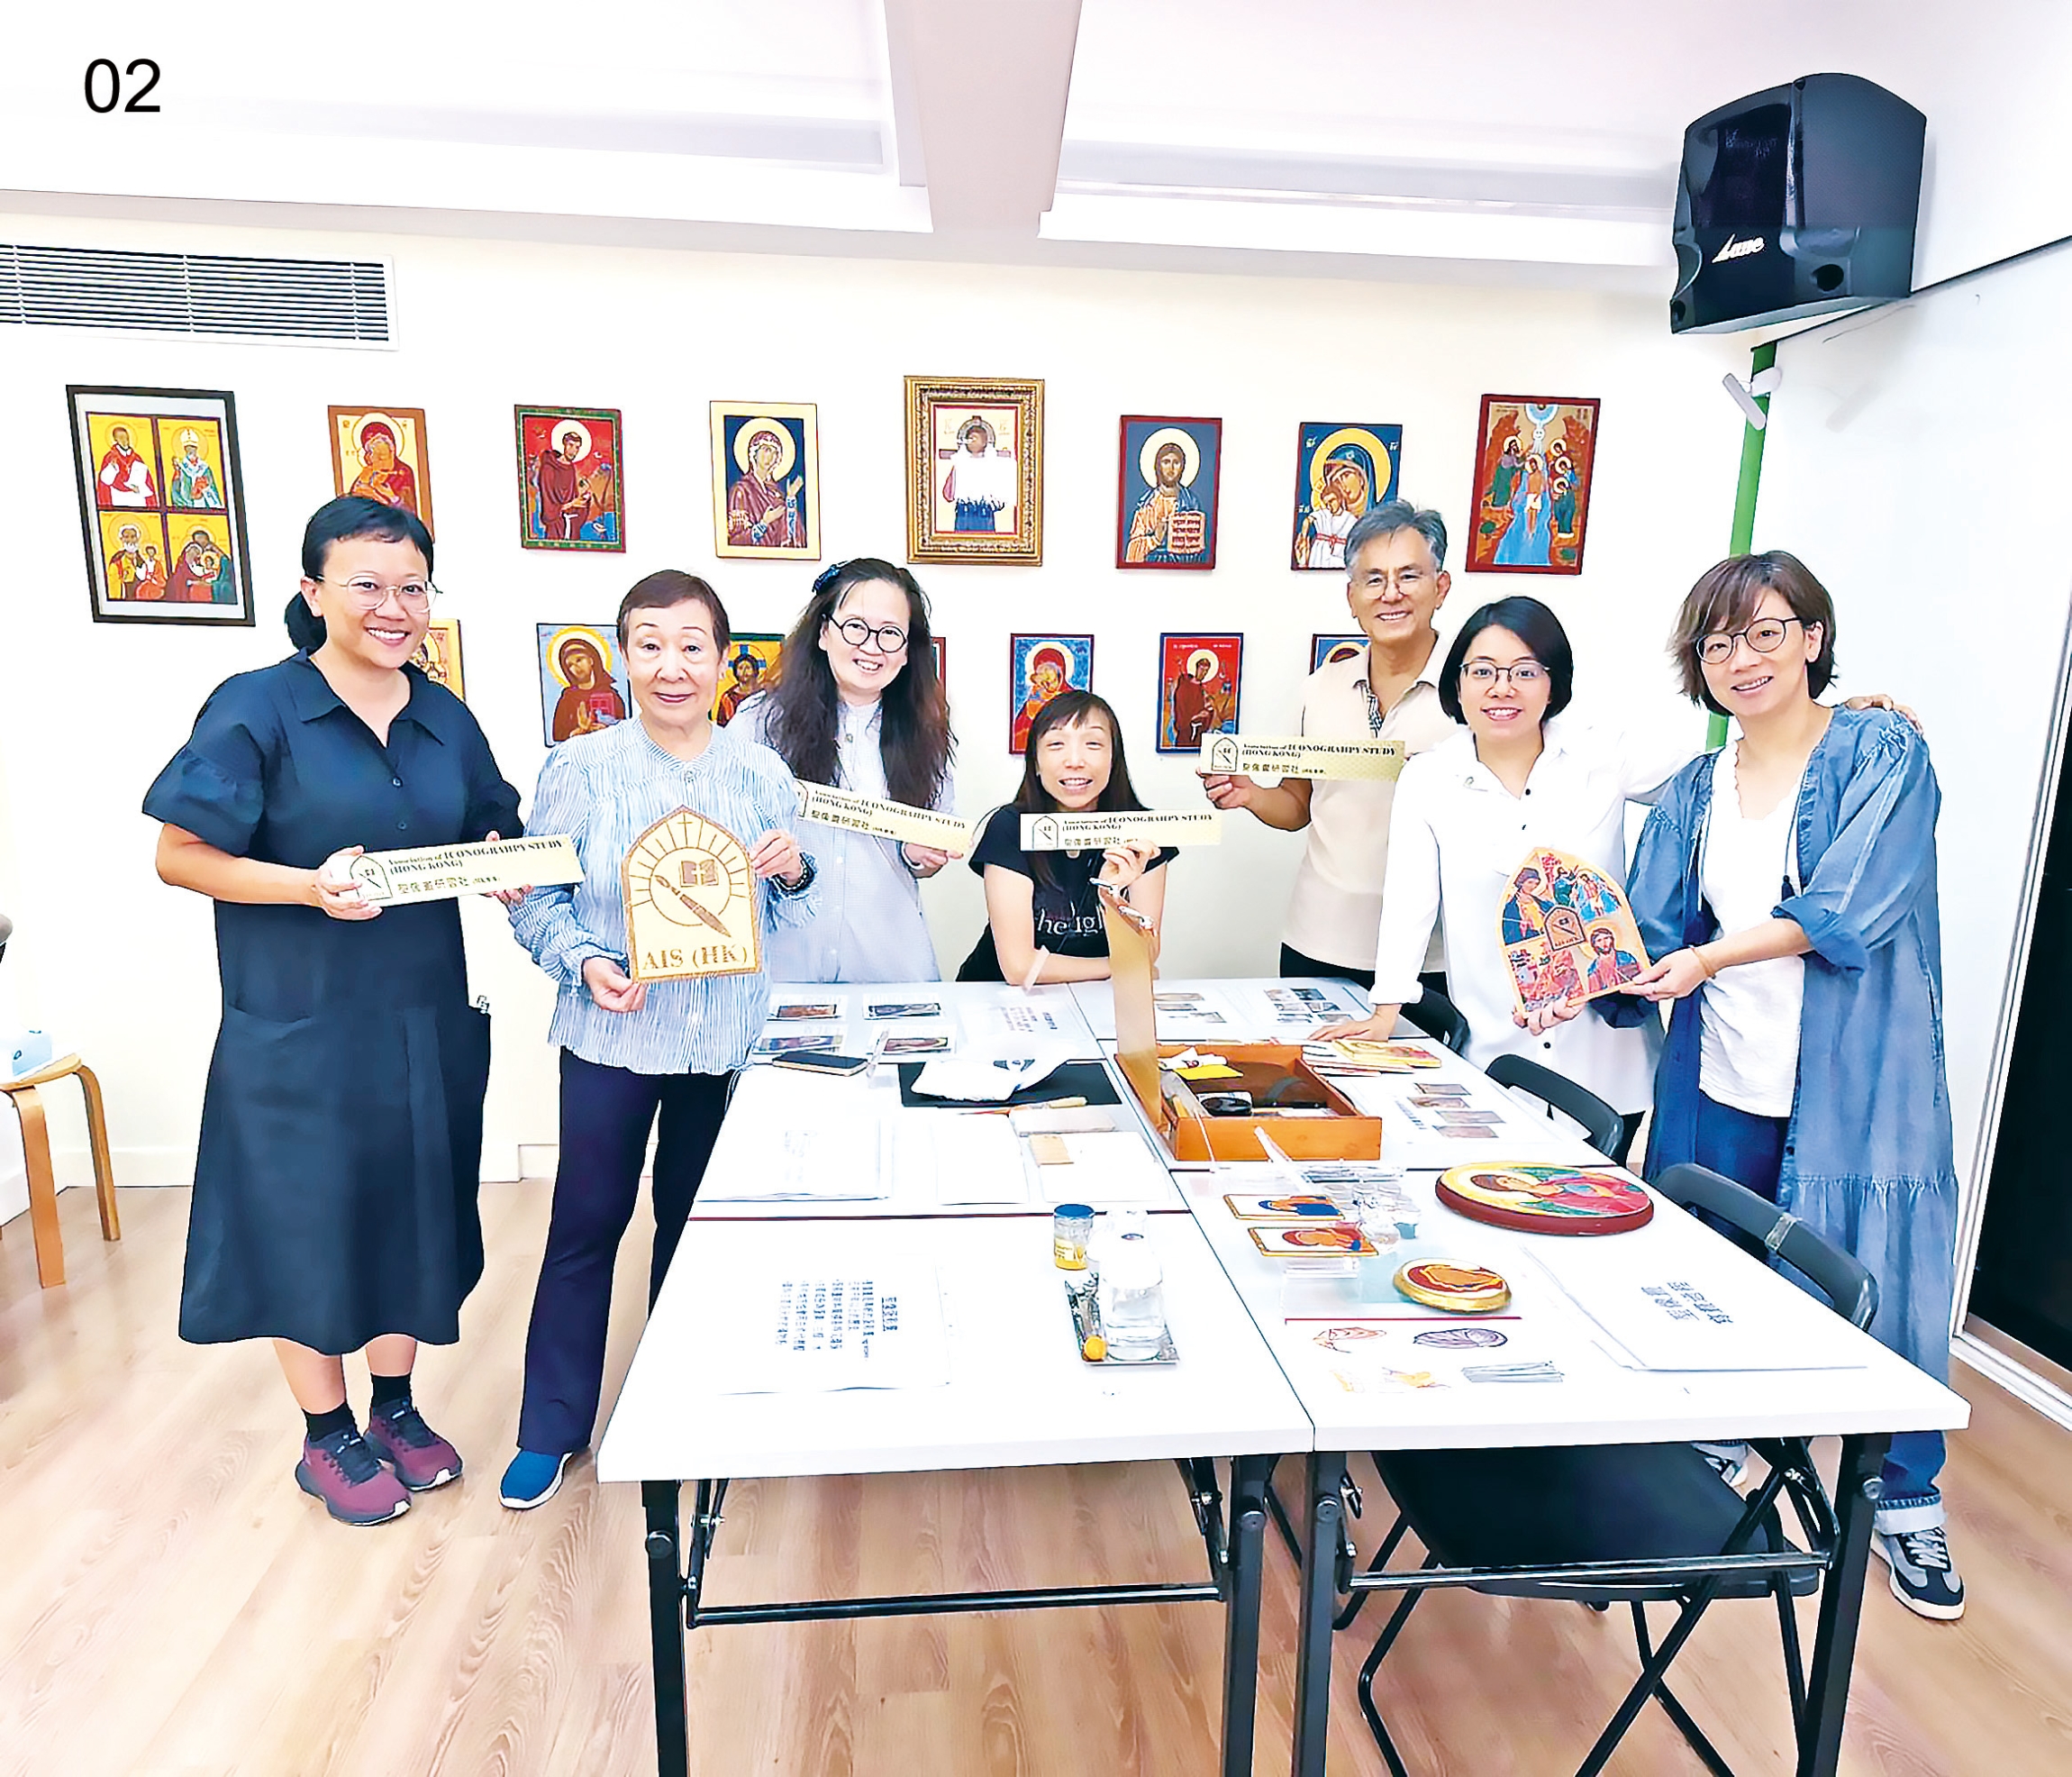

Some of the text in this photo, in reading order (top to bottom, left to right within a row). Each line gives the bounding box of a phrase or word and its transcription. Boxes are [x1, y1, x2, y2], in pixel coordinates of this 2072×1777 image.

[1362, 747, 1395, 755] STUDY
[812, 796, 873, 817] (HONG KONG)
[935, 817, 966, 829] STUDY
[1181, 814, 1213, 822] STUDY
[528, 839, 563, 850] STUDY
[389, 860, 463, 875] (HONG KONG)
[642, 943, 748, 971] AIS (HK)
